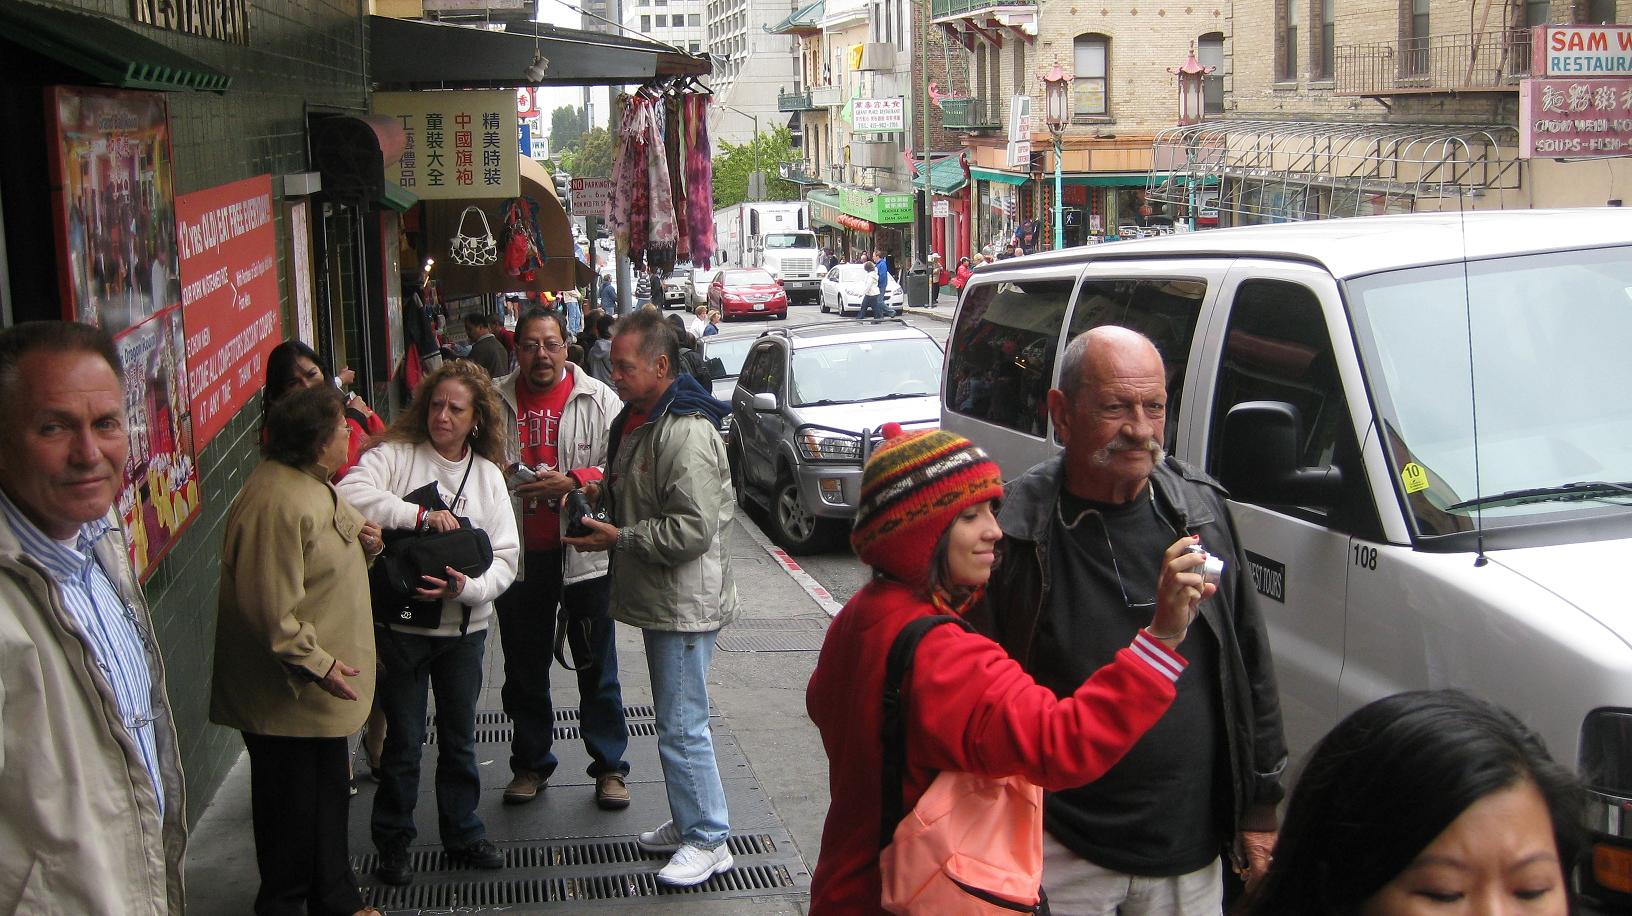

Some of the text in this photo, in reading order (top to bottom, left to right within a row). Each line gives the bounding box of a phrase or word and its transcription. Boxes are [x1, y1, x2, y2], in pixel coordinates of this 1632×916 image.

[1551, 31, 1608, 52] SAM
[1535, 120, 1573, 133] CHOW
[426, 113, 445, 186] 童裝大全
[454, 112, 473, 186] 中國旗袍
[482, 112, 501, 186] 精美時裝
[572, 179, 610, 190] NO PARKING
[189, 224, 204, 255] YRS
[217, 206, 230, 243] EAT
[229, 202, 246, 238] FREE
[125, 343, 141, 364] Dragon
[209, 353, 218, 384] ALL
[200, 352, 261, 427] AT ANY TIME THANK YOU
[1406, 464, 1420, 479] 10
[1354, 544, 1377, 571] 108
[1262, 567, 1283, 599] TOURS
